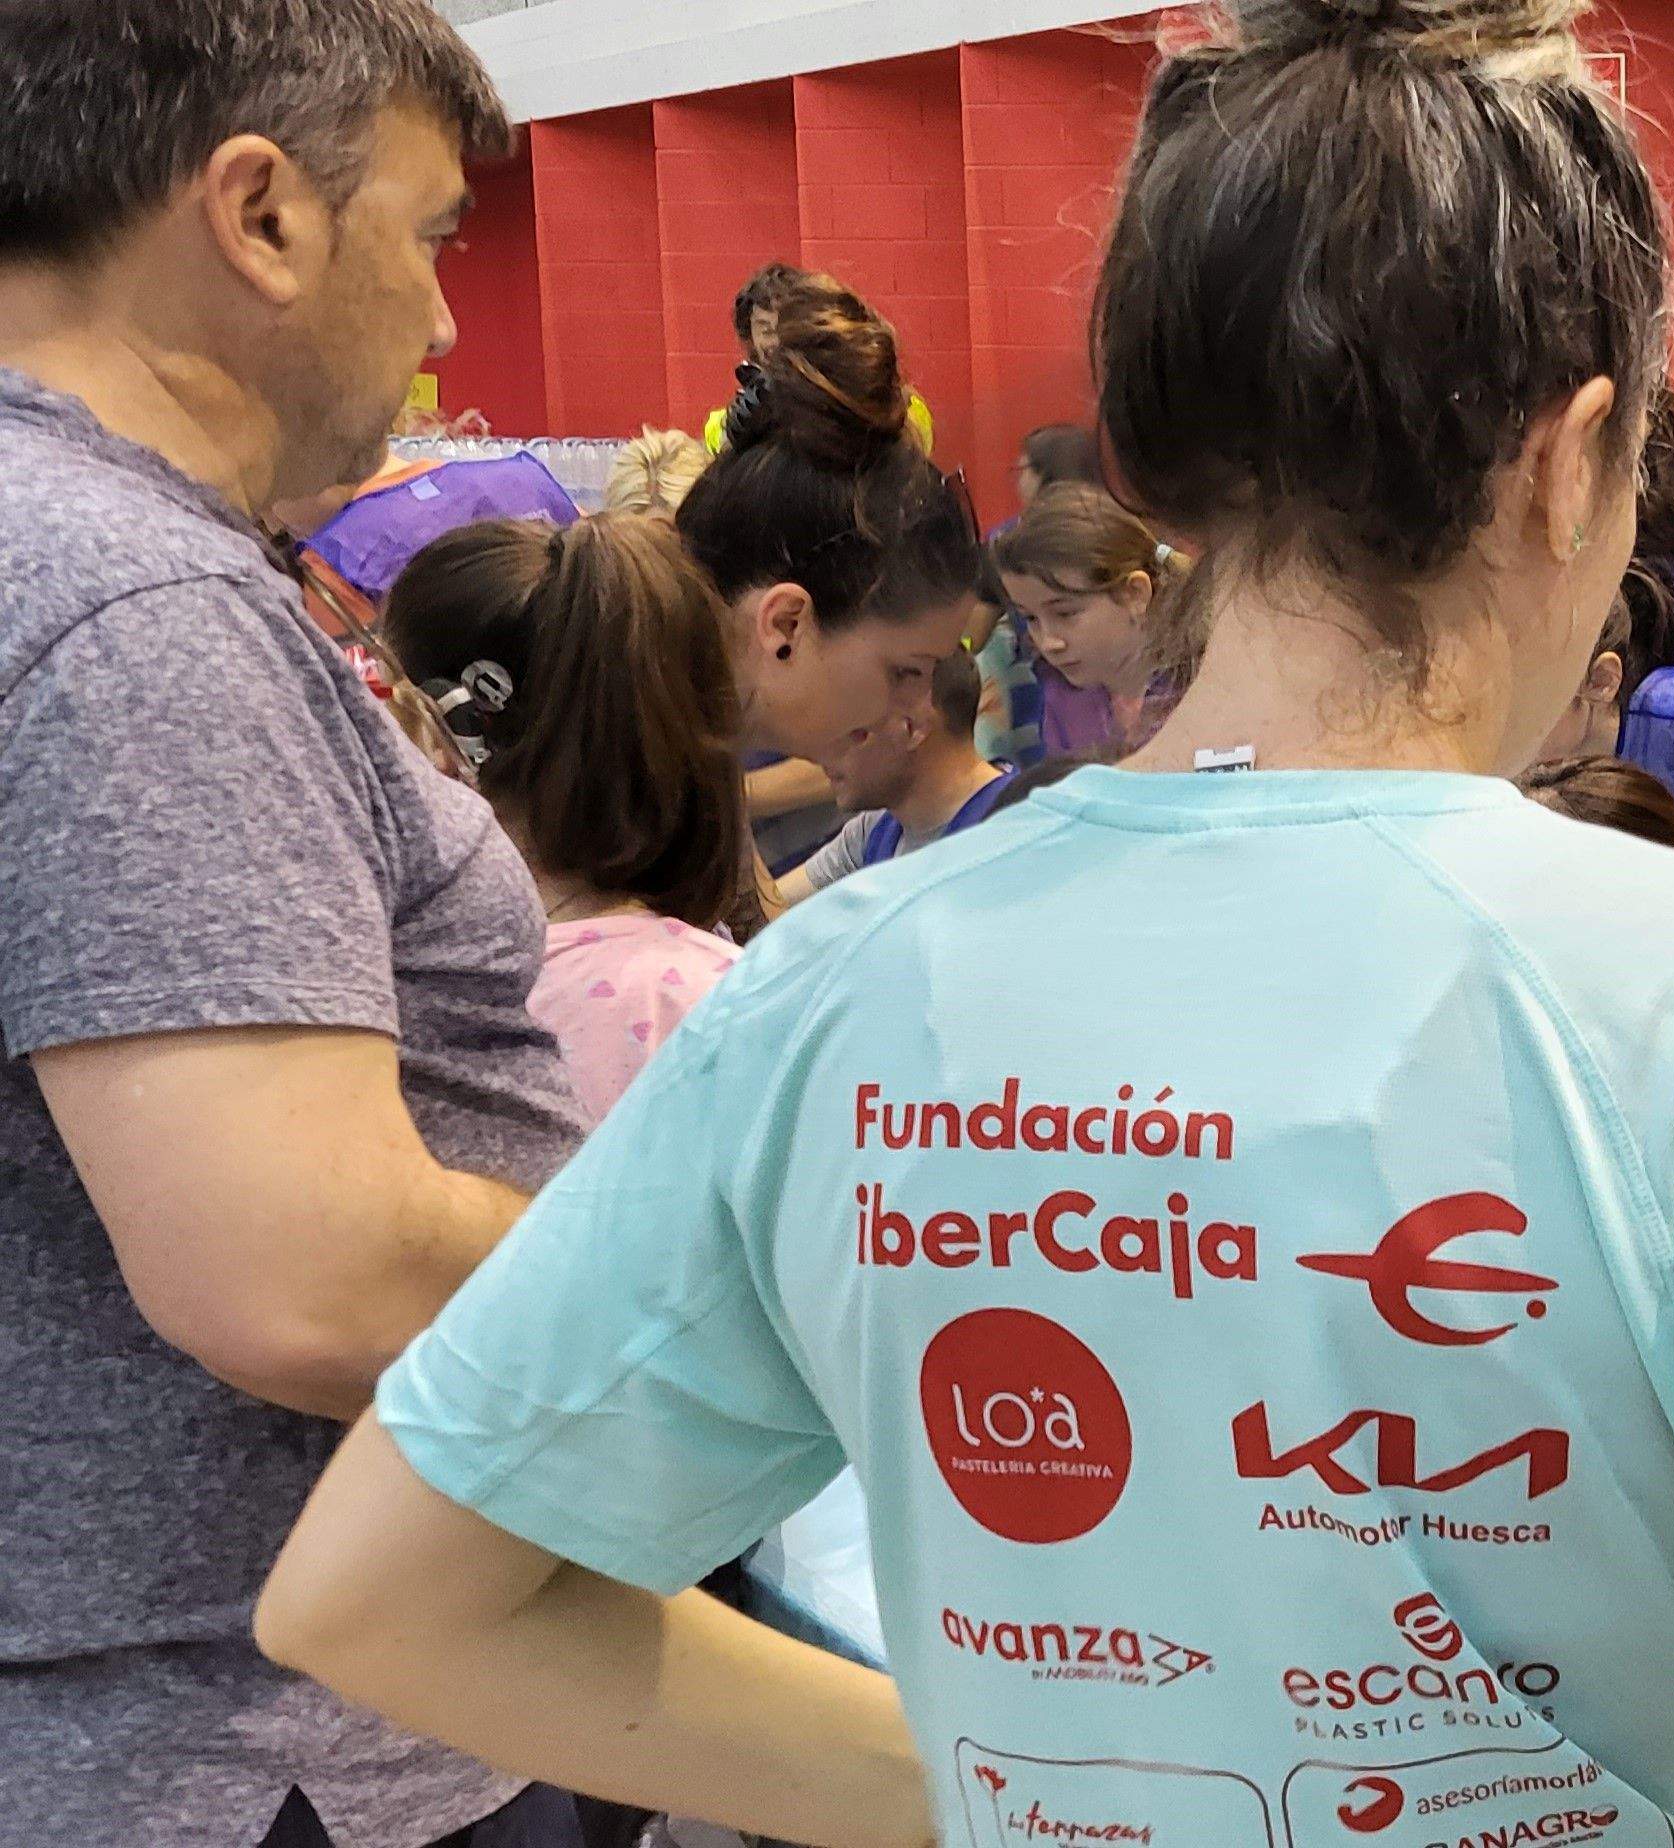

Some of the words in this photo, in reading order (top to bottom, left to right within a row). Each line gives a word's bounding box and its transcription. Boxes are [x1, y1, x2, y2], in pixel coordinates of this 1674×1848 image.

[855, 1078, 1234, 1160] Fundación
[856, 1183, 1258, 1299] iberCaja
[1422, 1513, 1551, 1545] Huesca
[942, 1607, 1144, 1667] avanza
[1295, 1713, 1425, 1741] PLASTIC
